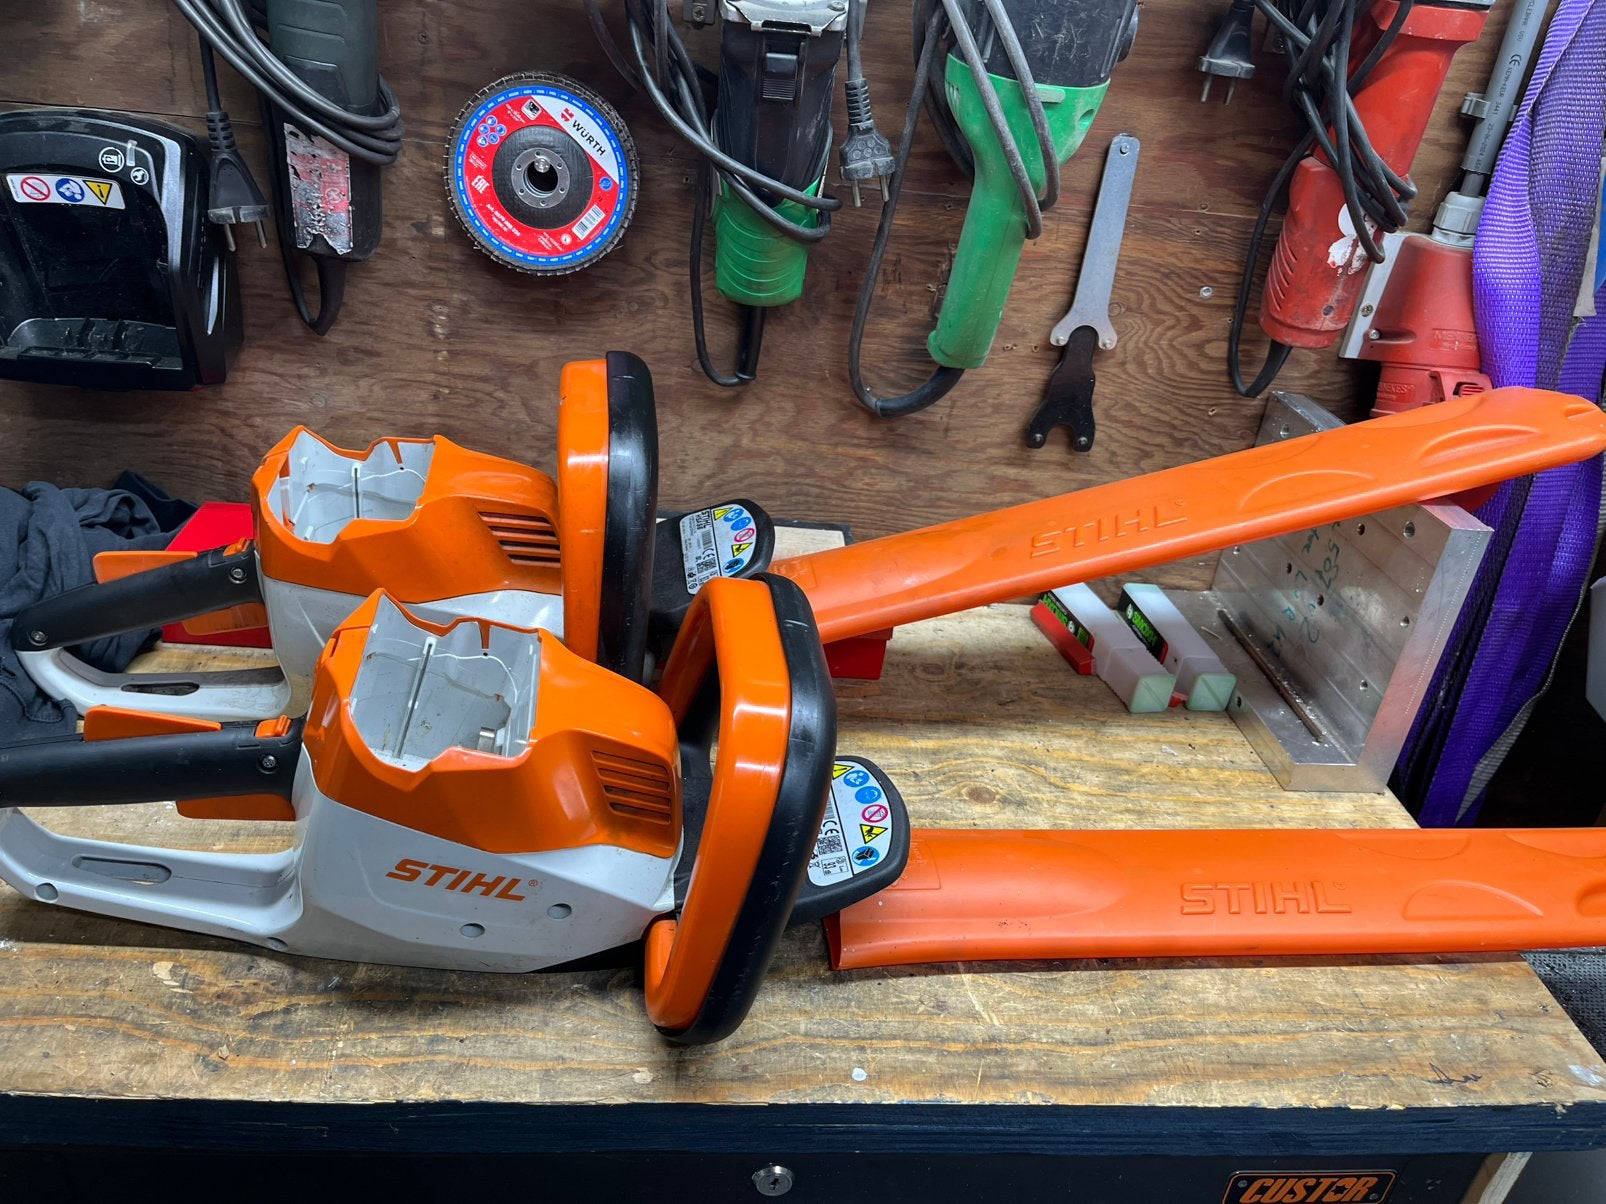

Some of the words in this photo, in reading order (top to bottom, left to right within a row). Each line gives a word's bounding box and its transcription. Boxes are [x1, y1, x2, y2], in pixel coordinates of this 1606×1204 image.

[572, 119, 606, 156] WÜRTH
[702, 511, 712, 528] STIHL
[1029, 505, 1188, 559] STIHL
[385, 858, 526, 902] STIHL
[1180, 880, 1353, 916] STIHL
[1239, 1176, 1379, 1204] CUSTOR
